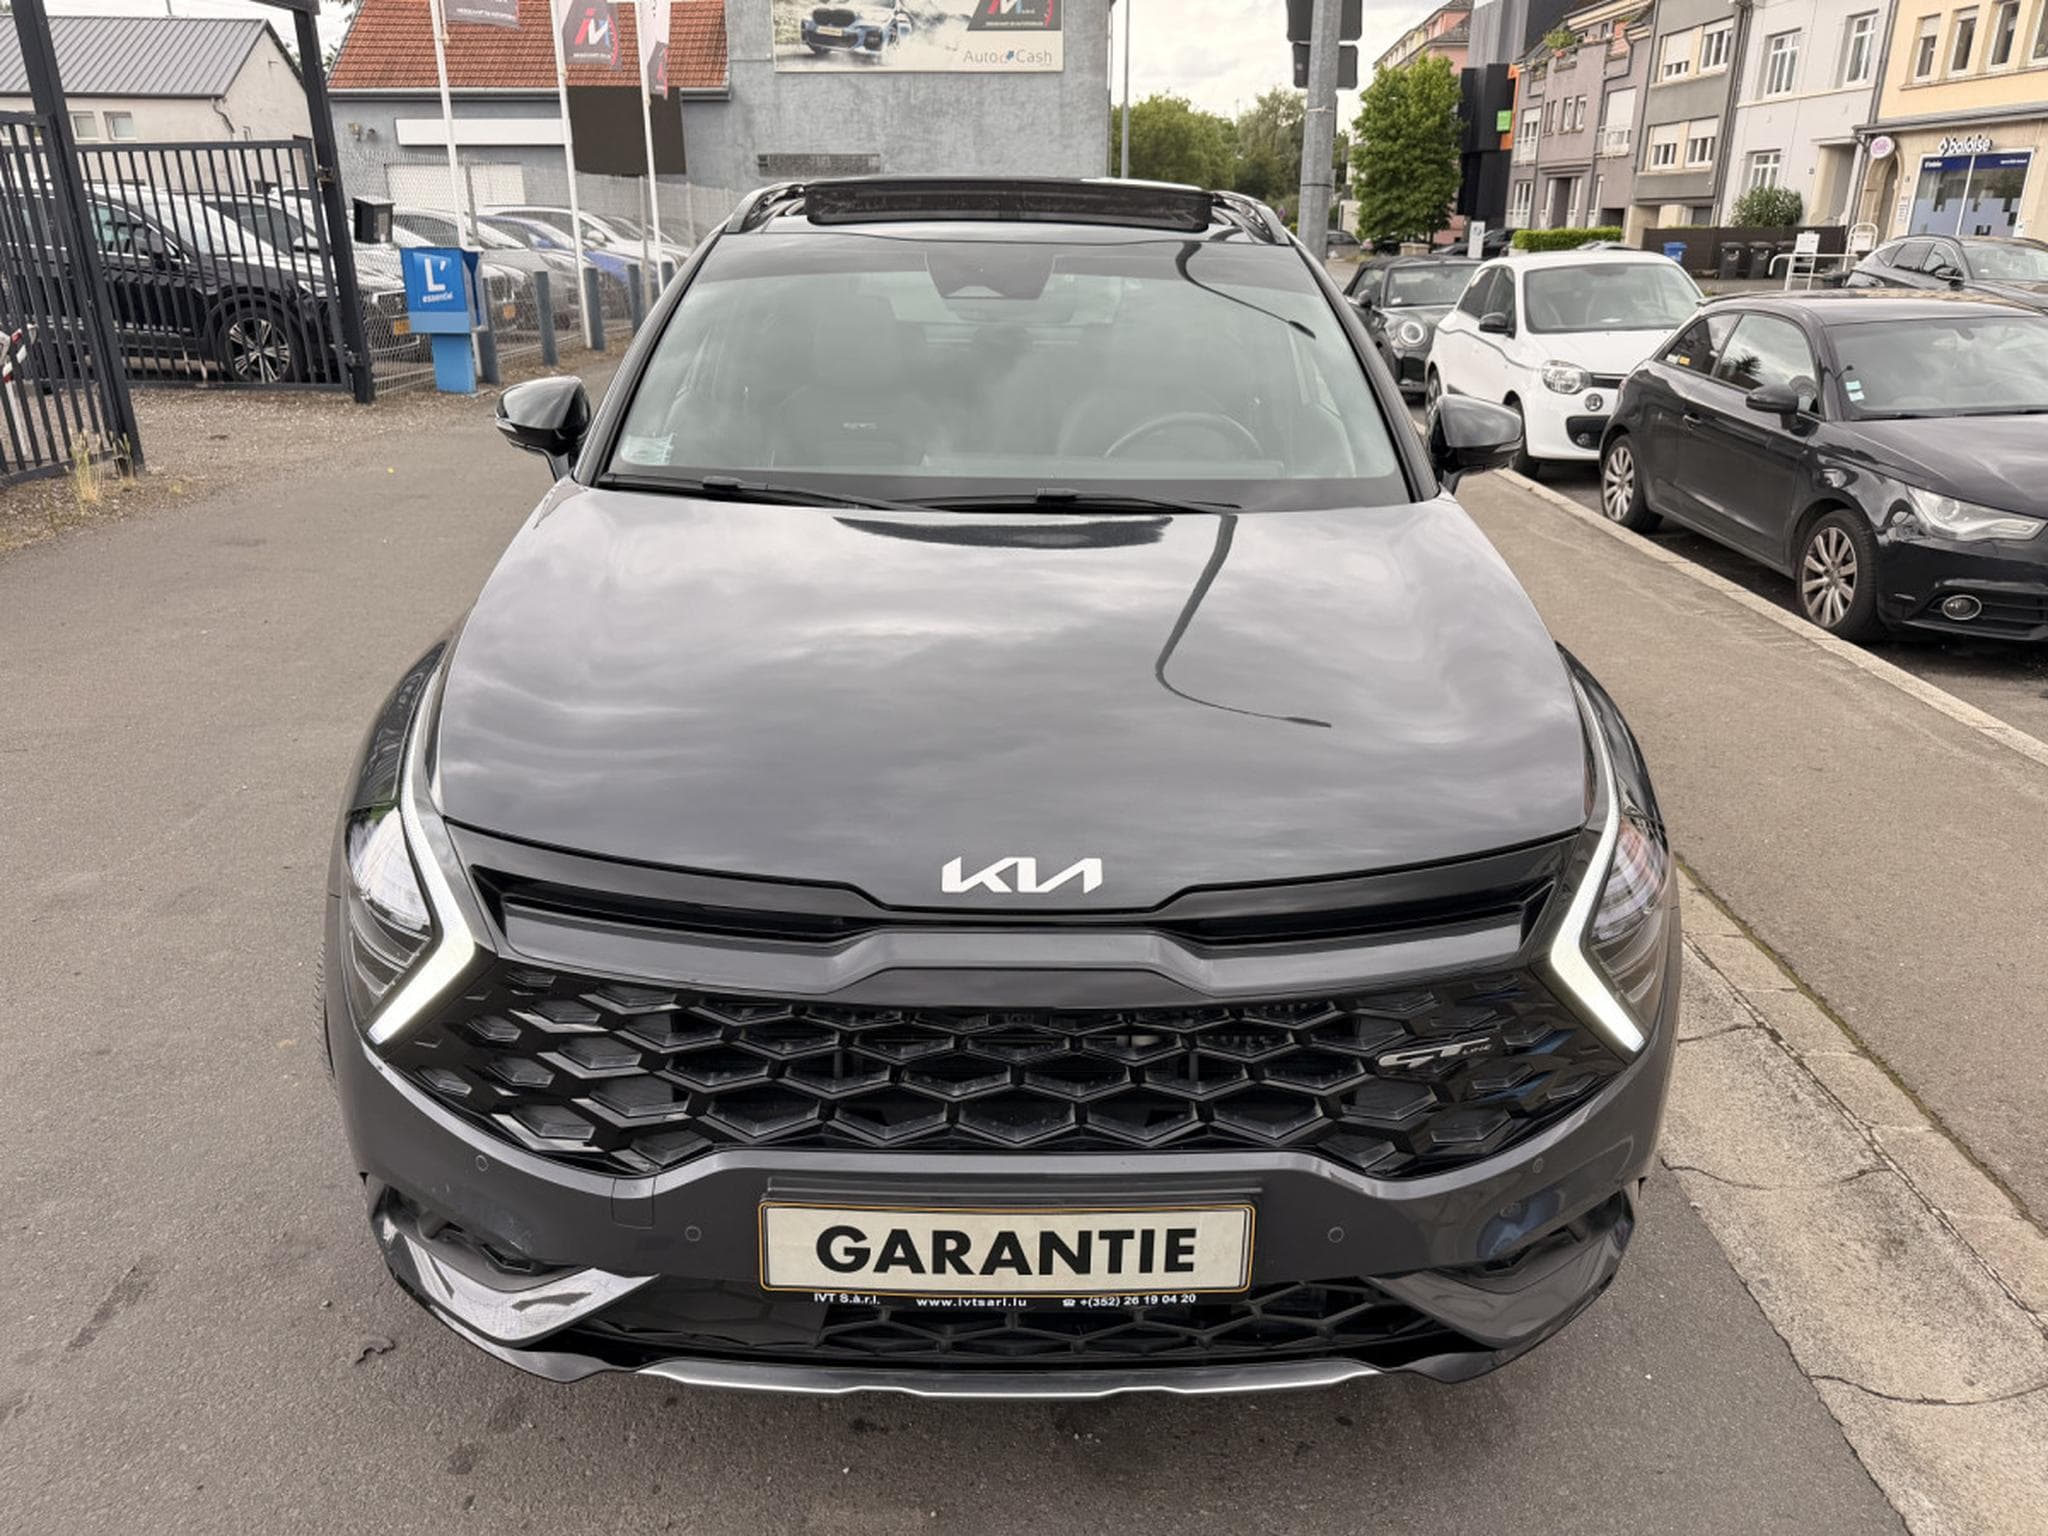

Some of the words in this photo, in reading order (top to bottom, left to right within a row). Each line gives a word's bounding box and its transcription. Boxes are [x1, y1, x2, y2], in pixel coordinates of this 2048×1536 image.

[1950, 134, 1992, 154] baloise
[424, 257, 447, 292] L'
[941, 855, 1103, 894] KIA
[815, 1224, 1198, 1276] GARANTIE
[813, 1292, 836, 1303] IVT
[915, 1297, 1027, 1307] www.ivtsarl.lu
[1080, 1296, 1120, 1308] +(352)
[1123, 1296, 1140, 1306] 26
[1144, 1295, 1159, 1305] 19
[1161, 1294, 1178, 1304] 04
[1180, 1293, 1197, 1303] 20
